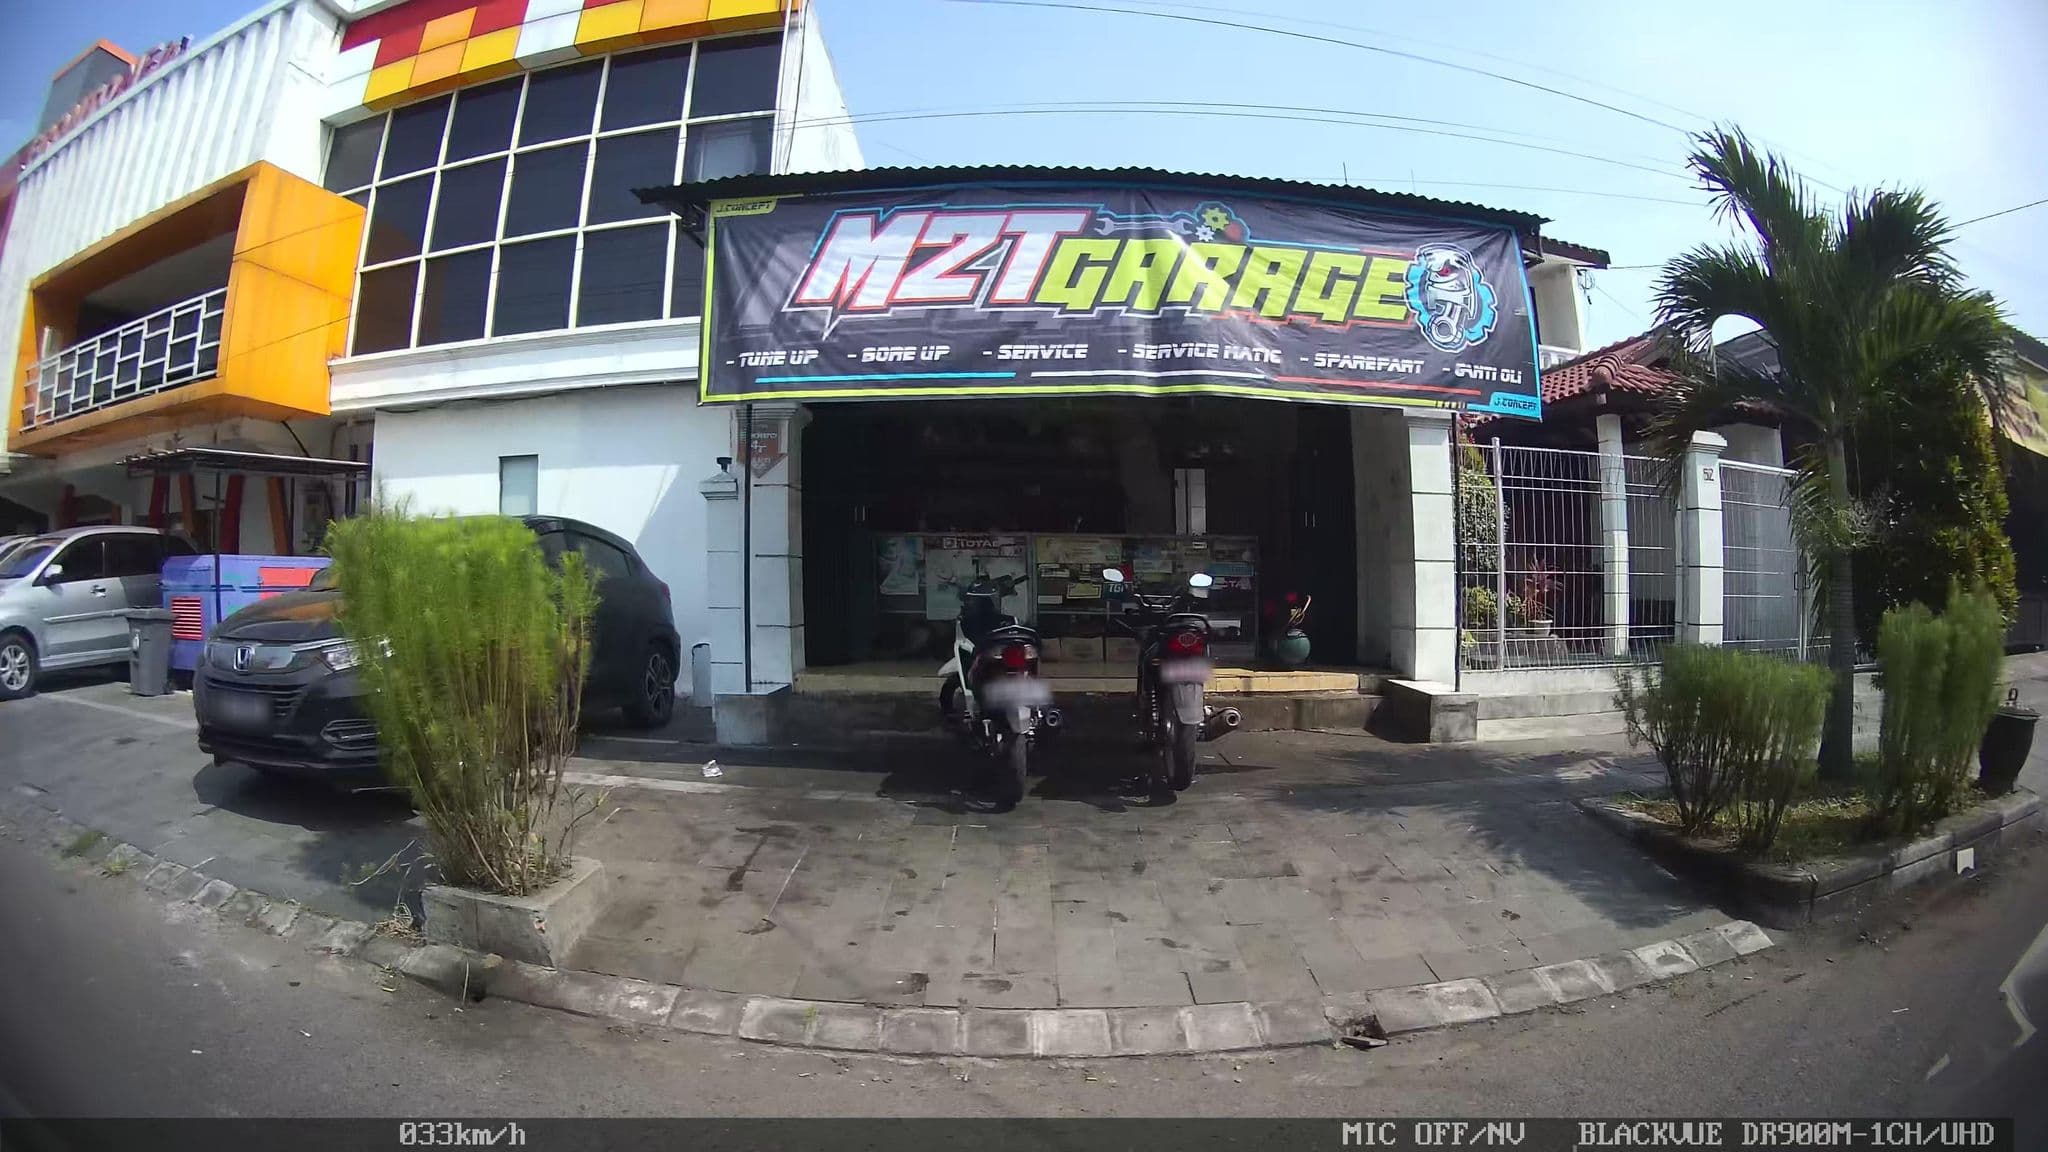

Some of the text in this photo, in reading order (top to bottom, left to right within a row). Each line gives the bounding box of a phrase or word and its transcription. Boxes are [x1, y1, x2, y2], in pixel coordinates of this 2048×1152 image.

[796, 210, 1408, 322] MZT GARAGE
[740, 350, 819, 367] TUNE UP
[920, 345, 950, 361] UP
[997, 344, 1089, 360] SERVICE
[1132, 342, 1281, 364] SERVICE MATIC
[1314, 353, 1424, 374] SPAREPART
[1500, 368, 1522, 384] OLI
